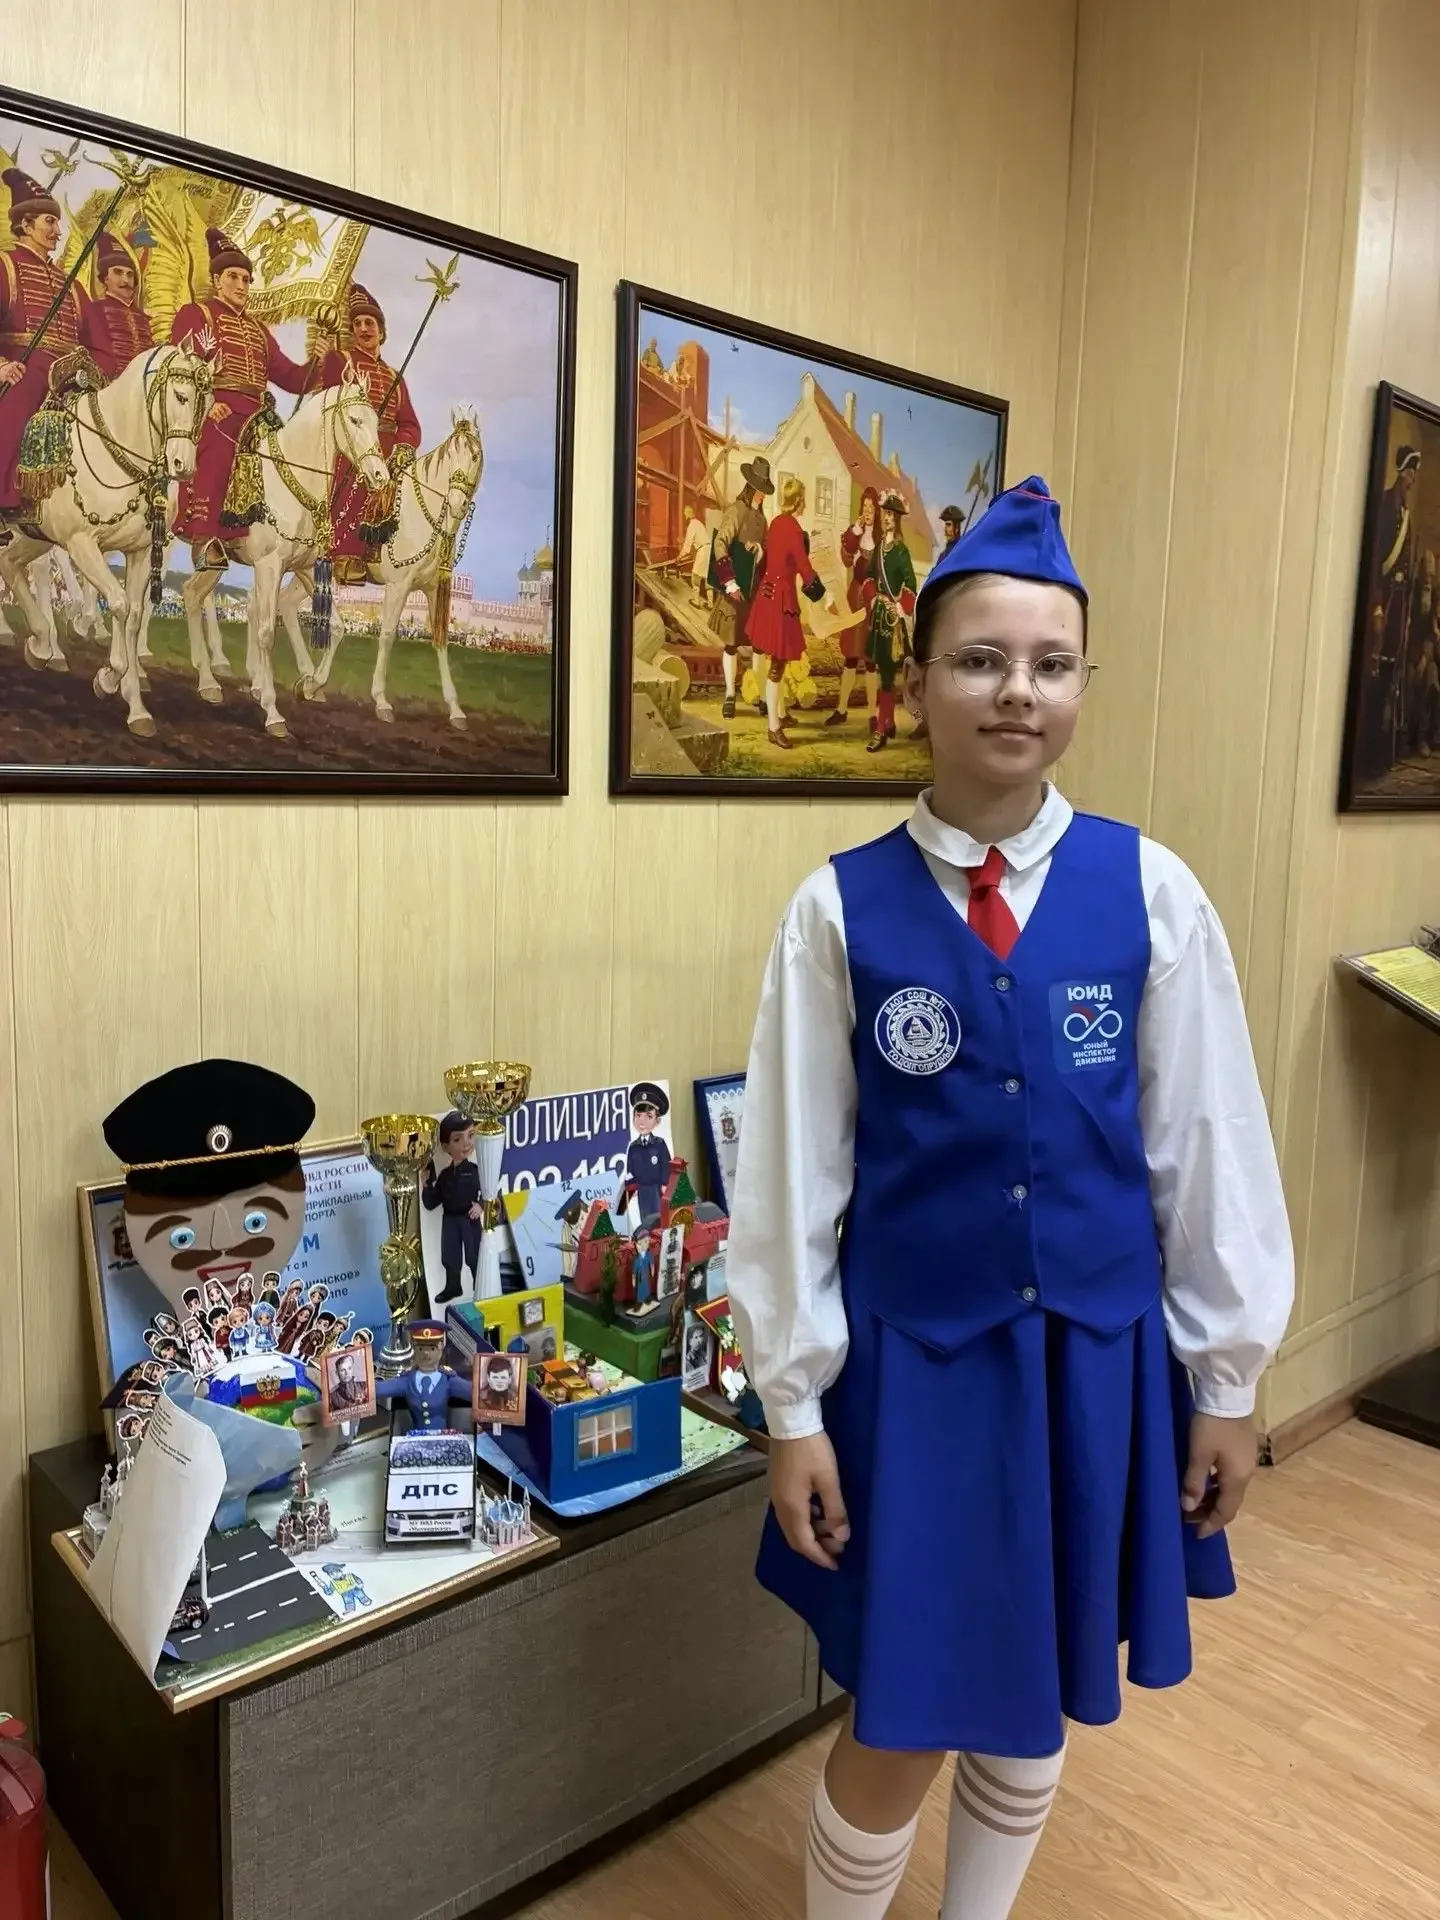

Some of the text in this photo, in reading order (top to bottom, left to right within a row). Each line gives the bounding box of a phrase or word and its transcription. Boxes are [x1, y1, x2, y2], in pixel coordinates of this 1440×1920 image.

[1067, 984, 1113, 1001] ЮИД
[884, 995, 904, 1016] МАОУ
[907, 991, 927, 1001] СОШ
[1083, 1040, 1109, 1050] ЮНЫЙ
[1072, 1047, 1117, 1059] ИНСПЕКТОР
[1075, 1055, 1116, 1067] ДВИЖЕНИЯ
[324, 1162, 369, 1179] РОССИИ
[307, 1180, 342, 1195] ЛАСТИ
[561, 1181, 573, 1192] 12
[304, 1208, 336, 1222] ПОРТА
[303, 1232, 320, 1253] М
[401, 1483, 459, 1500] ДПС
